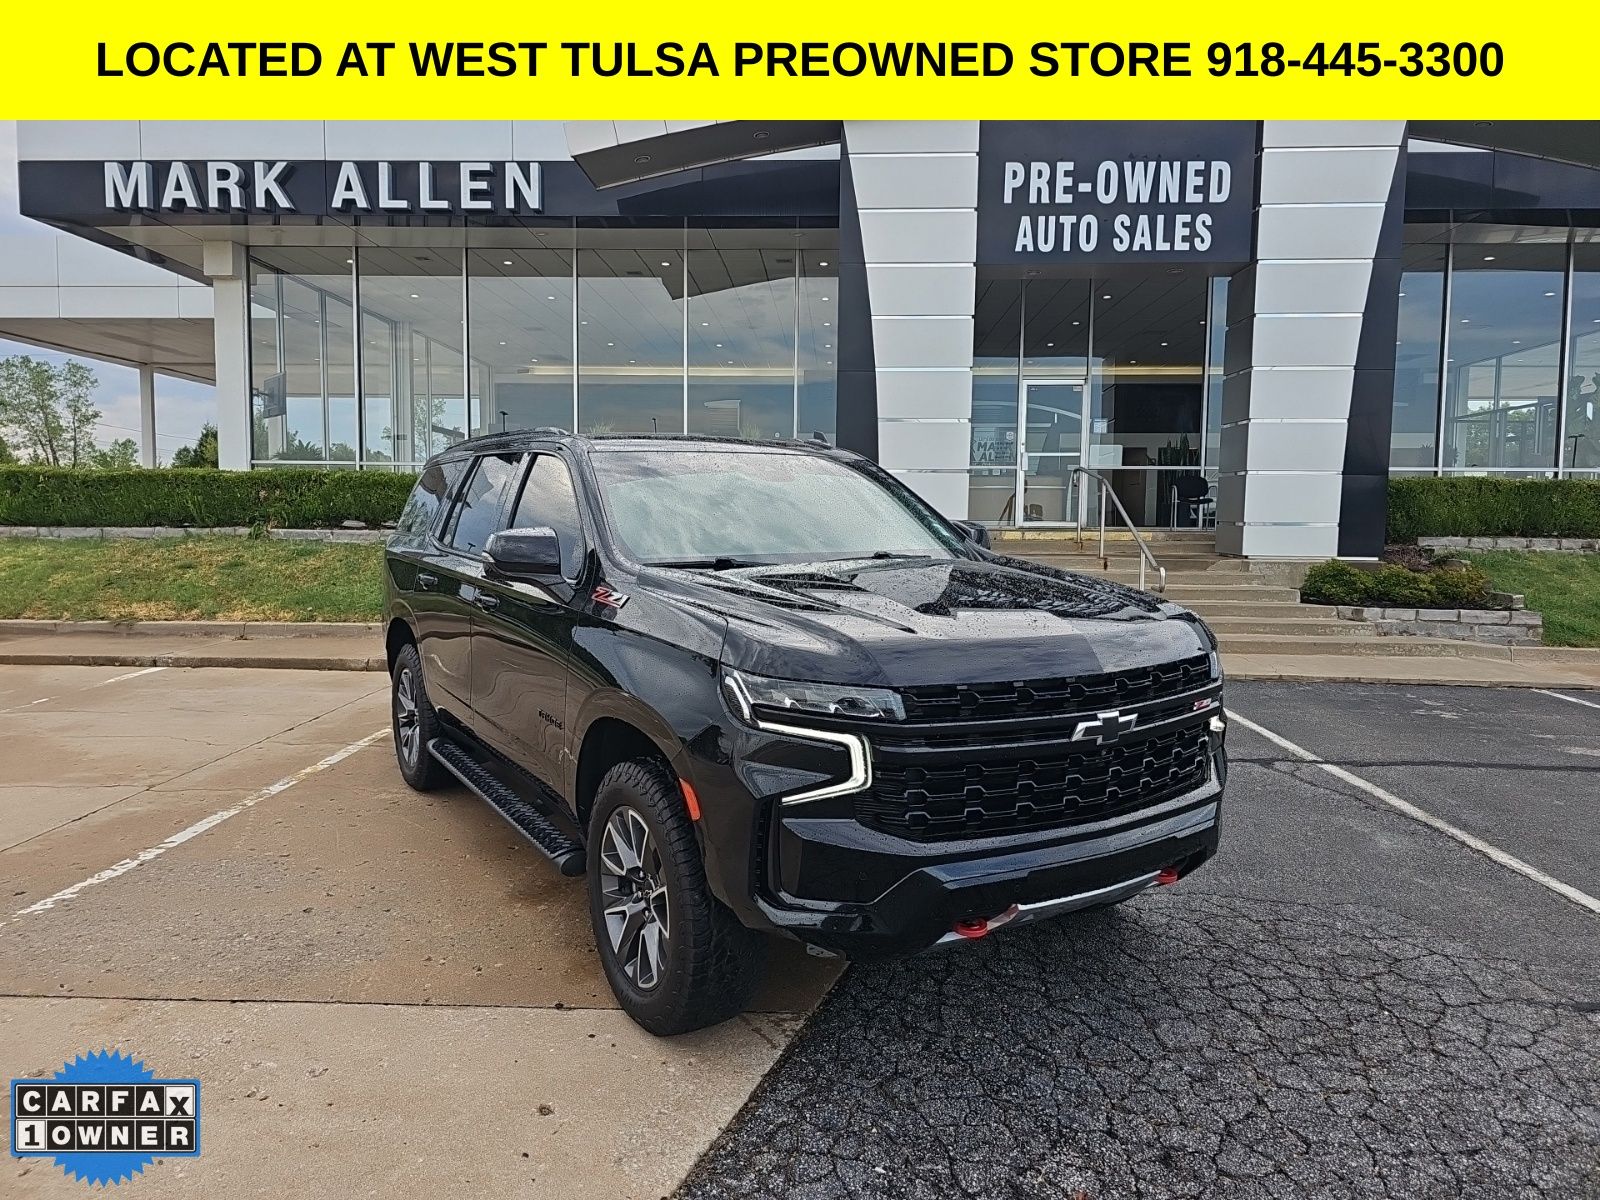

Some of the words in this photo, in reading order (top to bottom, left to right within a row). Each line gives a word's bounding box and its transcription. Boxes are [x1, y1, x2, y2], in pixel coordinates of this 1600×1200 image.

[103, 161, 293, 210] MARK
[331, 161, 541, 210] ALLEN
[1003, 160, 1231, 204] PRE-OWNED
[1015, 214, 1098, 252] AUTO
[1113, 213, 1213, 252] SALES
